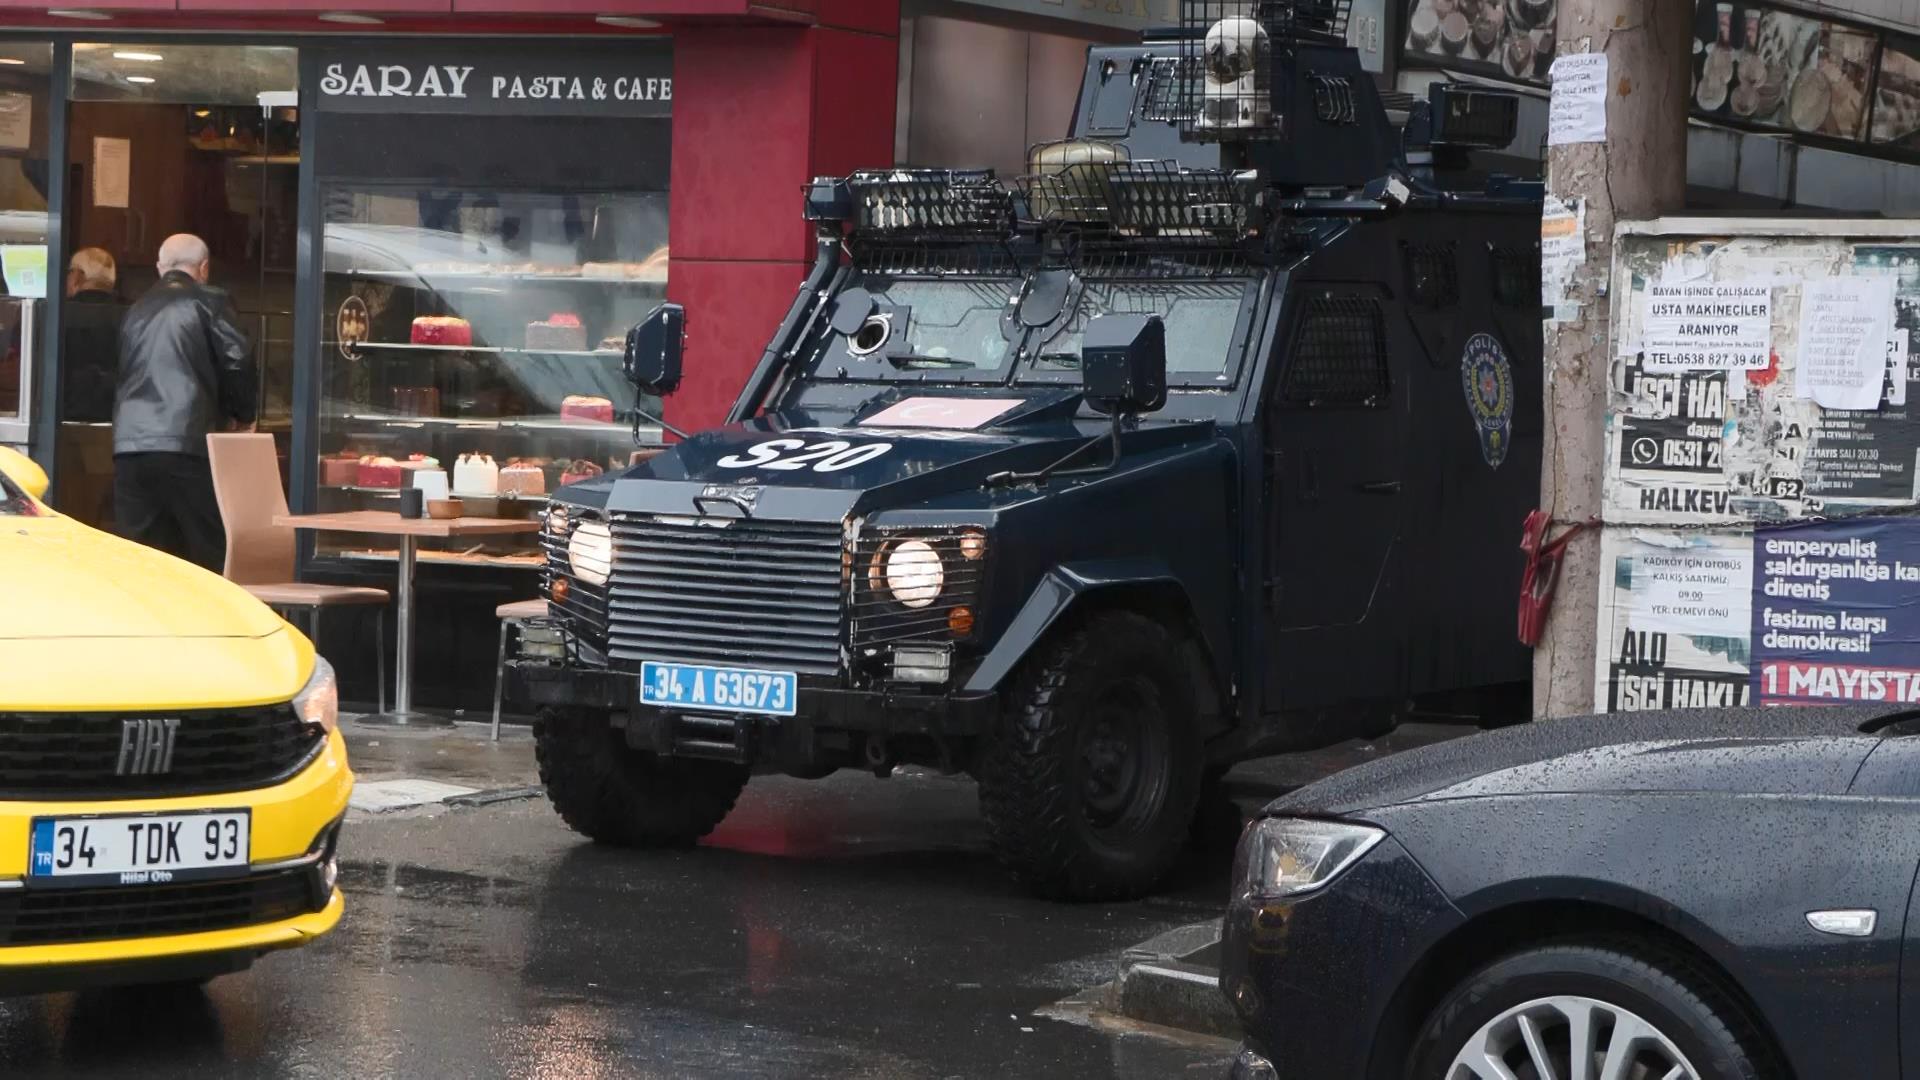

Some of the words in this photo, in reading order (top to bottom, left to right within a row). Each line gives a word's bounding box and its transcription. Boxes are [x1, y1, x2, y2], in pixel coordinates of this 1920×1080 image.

[320, 63, 474, 98] SARAY
[491, 76, 585, 99] PASTA
[591, 77, 607, 100] &
[613, 77, 672, 100] CAFE
[1653, 287, 1681, 296] BAYAN
[1652, 304, 1682, 315] USTA
[1686, 301, 1767, 316] MAKİNECİLER
[1678, 324, 1739, 335] ARANIYOR
[1651, 353, 1705, 365] TEL:0538
[1708, 354, 1729, 366] 827
[1732, 354, 1747, 366] 39
[1749, 354, 1765, 366] 46
[1687, 379, 1726, 419] HA
[716, 439, 893, 472] S20
[1662, 439, 1702, 467] 0531
[1840, 449, 1856, 458] SALI
[1777, 481, 1798, 497] 62
[1765, 538, 1877, 559] emperyalist
[1704, 560, 1742, 570] OTOBÜS
[1764, 557, 1890, 582] saldırganlığa
[1764, 577, 1830, 600] direniş
[1763, 607, 1836, 630] faşizme
[1840, 611, 1887, 634] karşı
[1620, 627, 1667, 665] ALO
[1763, 629, 1871, 652] demokrasi!
[655, 667, 683, 700] 34
[692, 671, 705, 703] A
[714, 671, 787, 709] 63673
[1763, 665, 1777, 694] 1
[116, 719, 181, 776] FIAT
[37, 853, 51, 866] TR
[56, 826, 96, 869] 34
[128, 821, 183, 866] TDK
[205, 819, 239, 861] 93
